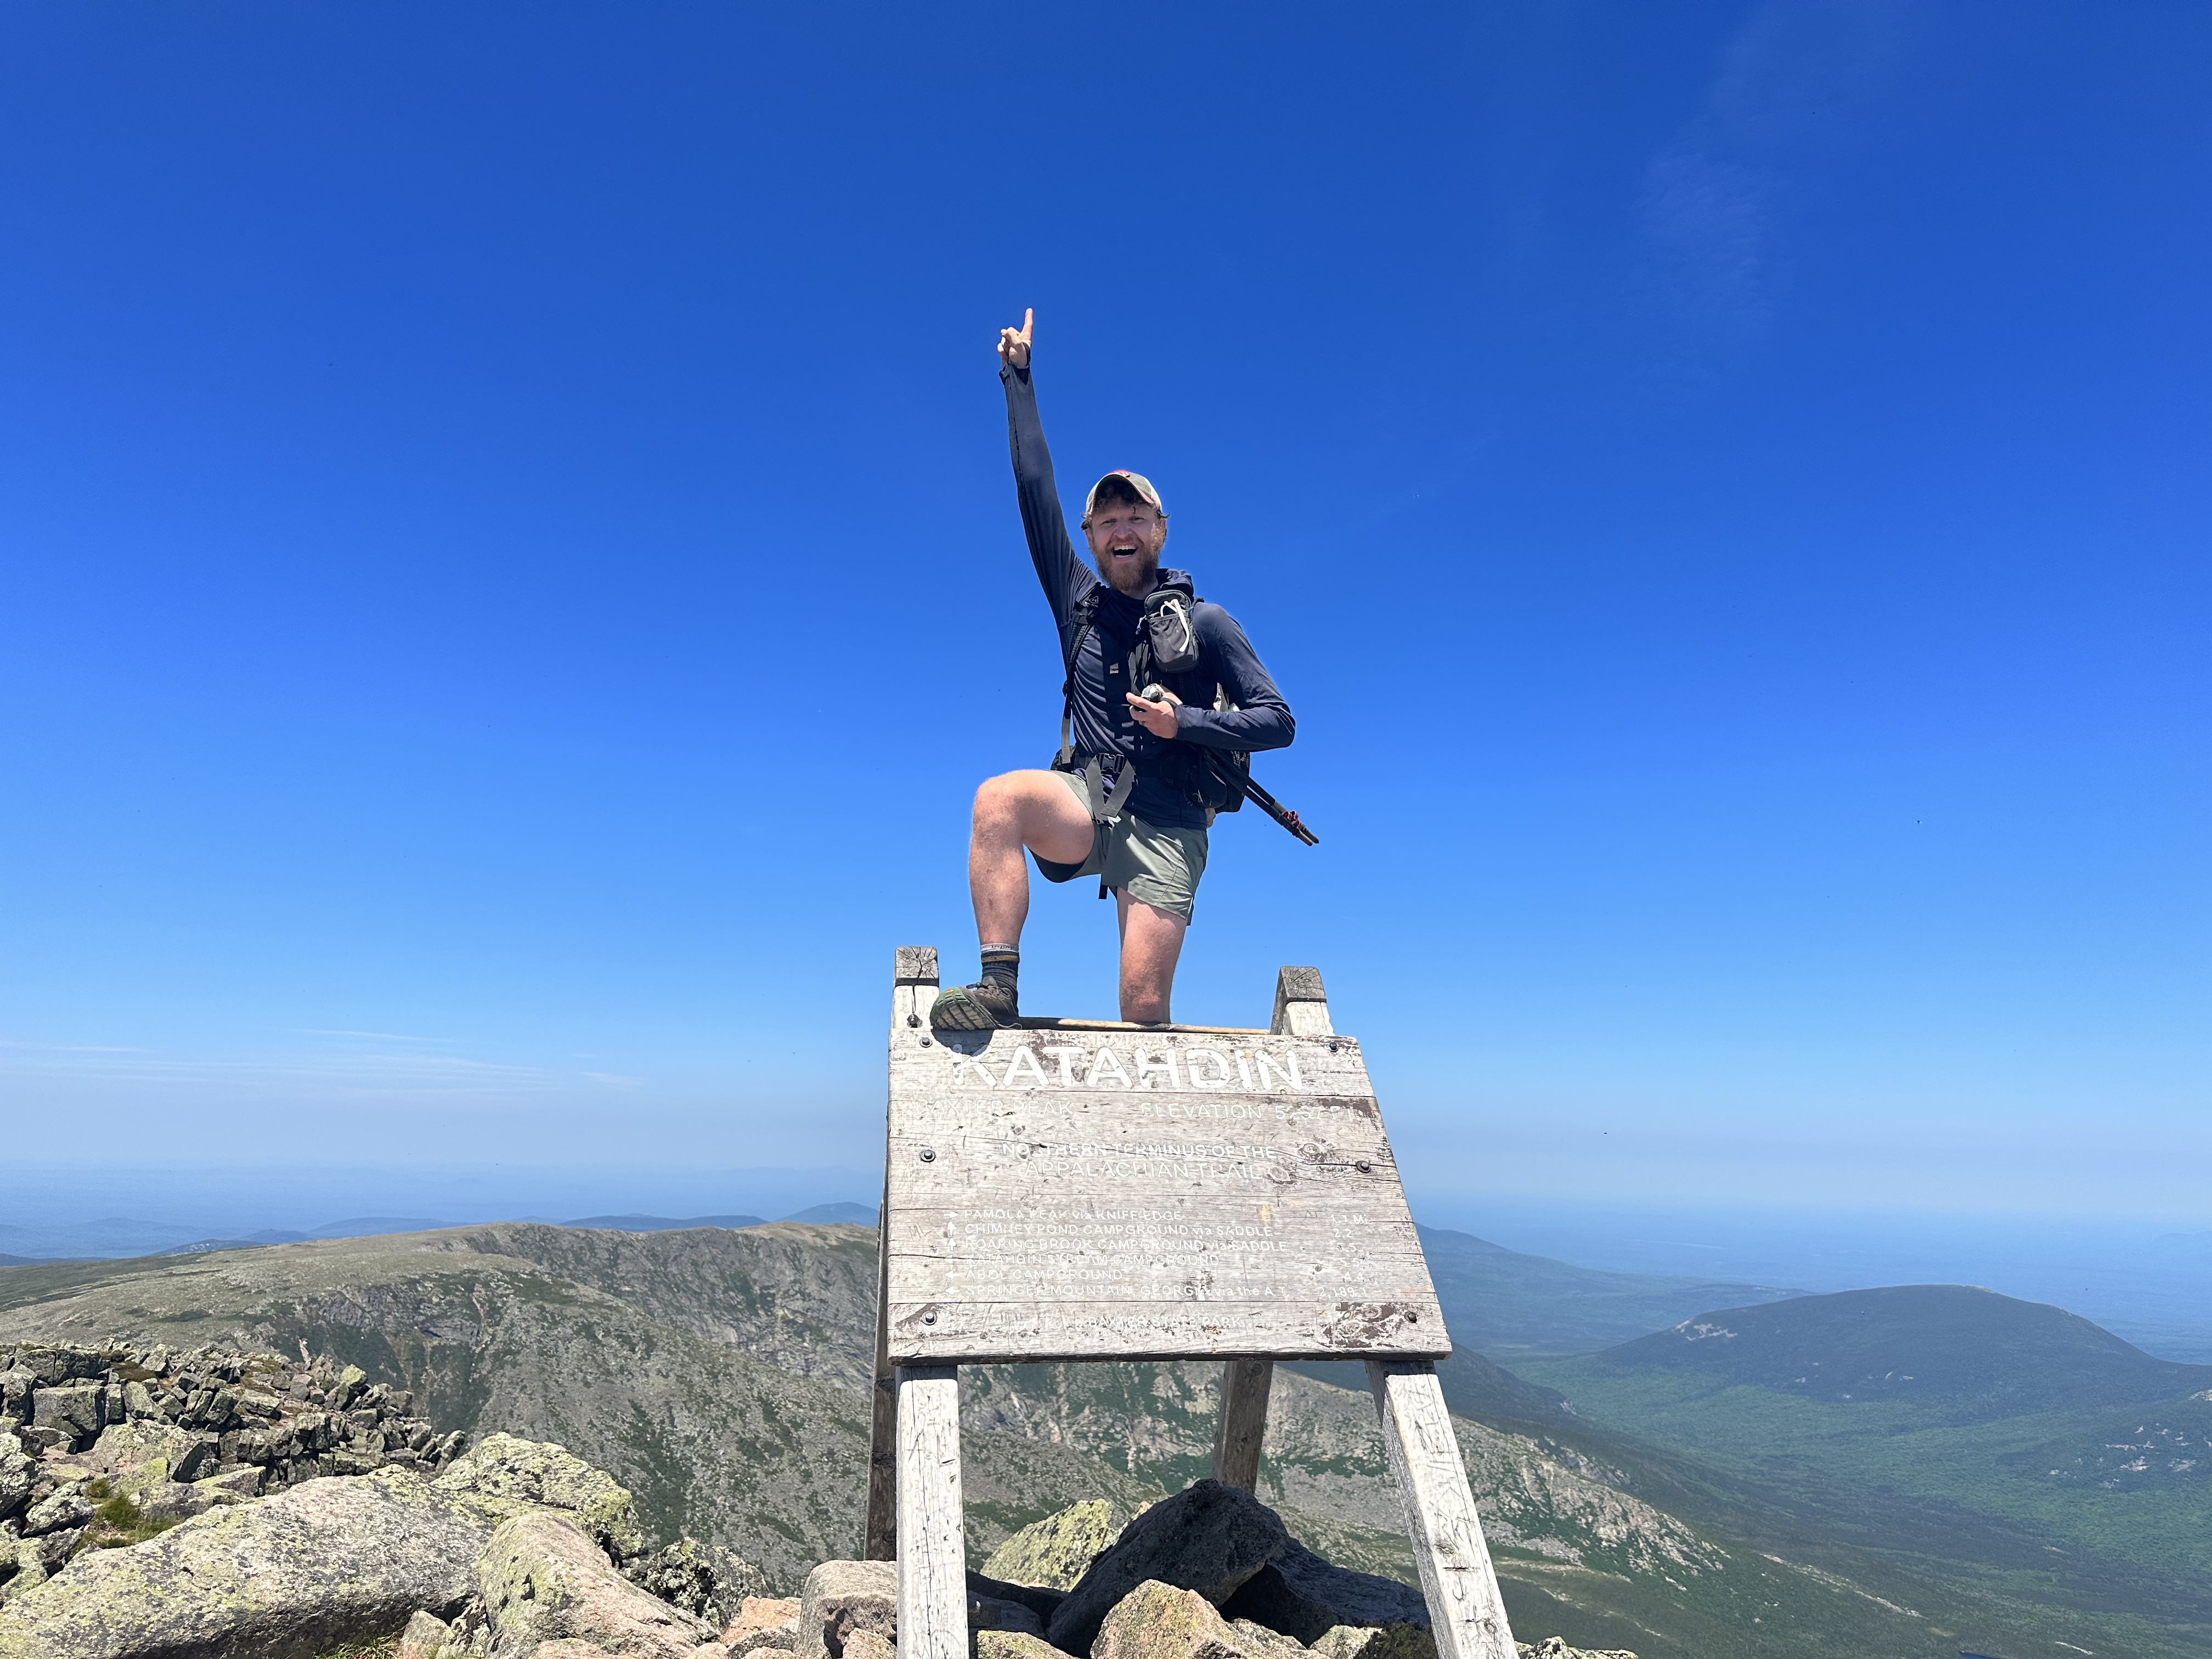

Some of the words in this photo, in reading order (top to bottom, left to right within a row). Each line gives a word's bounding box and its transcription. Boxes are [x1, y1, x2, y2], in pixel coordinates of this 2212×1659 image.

[952, 1043, 1304, 1091] KATAHDIN
[1013, 1100, 1073, 1116] PEAK
[1141, 1102, 1262, 1119] ELEVATION
[1115, 1143, 1206, 1157] TERMINUS
[1211, 1145, 1234, 1158] OF
[1240, 1146, 1277, 1159] THE
[1025, 1161, 1189, 1178] APPALACHIAN
[1197, 1163, 1262, 1180] TRAIL
[964, 1209, 1025, 1220] PAMOLA
[1030, 1209, 1068, 1220] PEAK
[1072, 1210, 1092, 1220] via
[1097, 1210, 1139, 1221] KNIFE
[1143, 1210, 1183, 1221] EDGE
[964, 1223, 1033, 1235] CHIMNEY
[1037, 1224, 1079, 1234] POND
[1083, 1224, 1188, 1235] CAMPGROUND
[1192, 1225, 1212, 1235] via
[1216, 1225, 1273, 1236] SADDLE
[1333, 1228, 1352, 1238] 2.2
[965, 1238, 1035, 1249] ROARING
[1039, 1238, 1093, 1250] BROOK
[1097, 1239, 1204, 1250] CAMPGROUND
[1207, 1240, 1227, 1251] via
[1232, 1240, 1289, 1251] SADDLE
[965, 1254, 1042, 1265] KATAHDIN
[1047, 1254, 1108, 1265] STREAM
[1113, 1255, 1219, 1266] CAMPGROUND
[966, 1268, 1008, 1280] ABOL
[1012, 1268, 1122, 1280] CAMPGROUND
[966, 1284, 1046, 1296] SPRINGER
[1214, 1285, 1234, 1296] via
[1237, 1286, 1260, 1296] the
[1087, 1316, 1149, 1328] BAXTER
[1152, 1316, 1197, 1328] STATE
[1202, 1316, 1243, 1328] PARK
